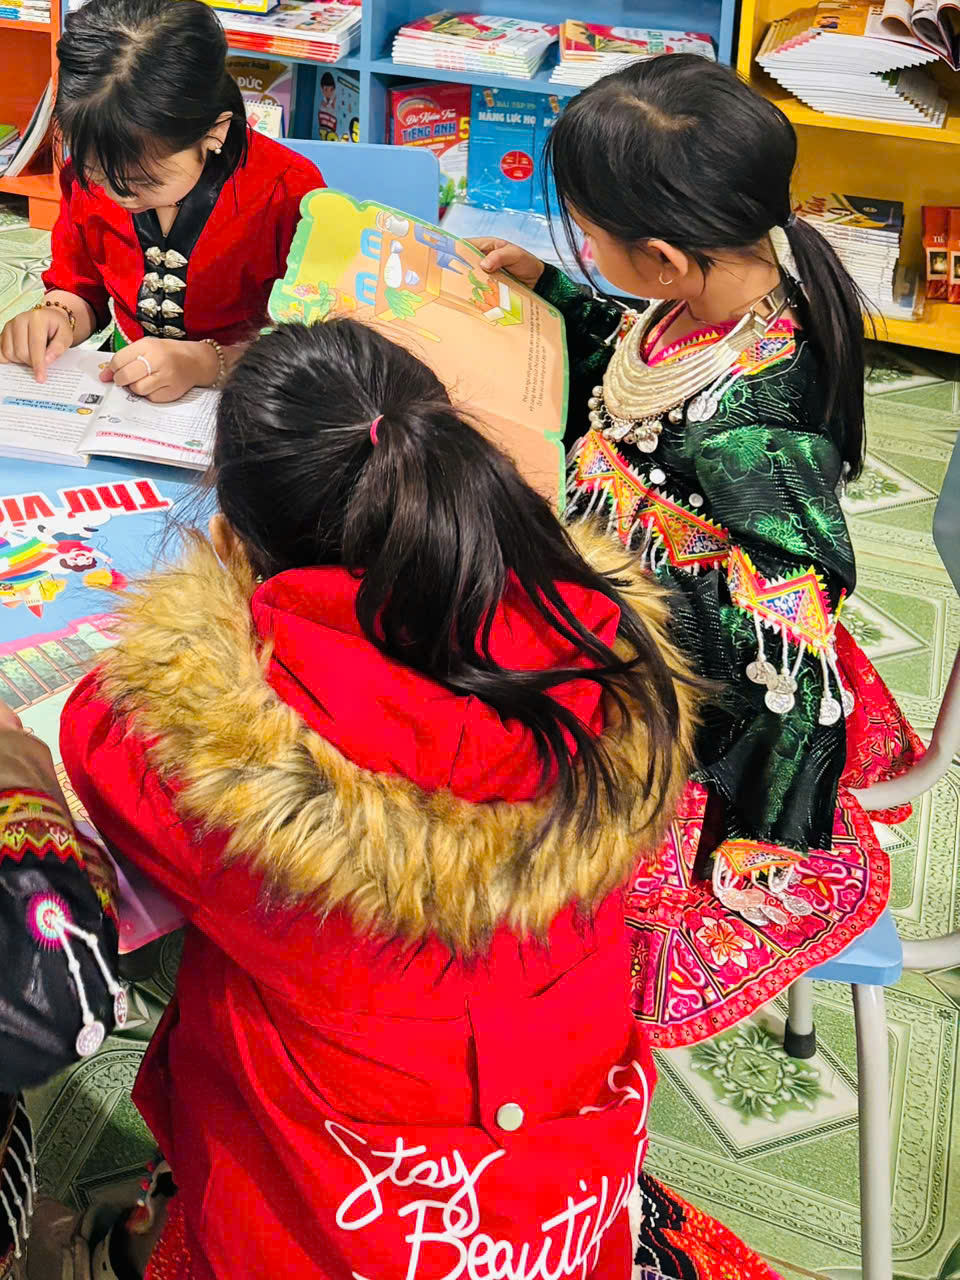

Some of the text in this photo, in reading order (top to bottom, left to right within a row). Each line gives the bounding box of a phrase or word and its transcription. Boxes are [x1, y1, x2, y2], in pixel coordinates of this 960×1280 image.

[401, 117, 470, 142] TIẾNG ANH 5
[62, 480, 170, 519] Thư
[324, 1120, 506, 1239] Stay
